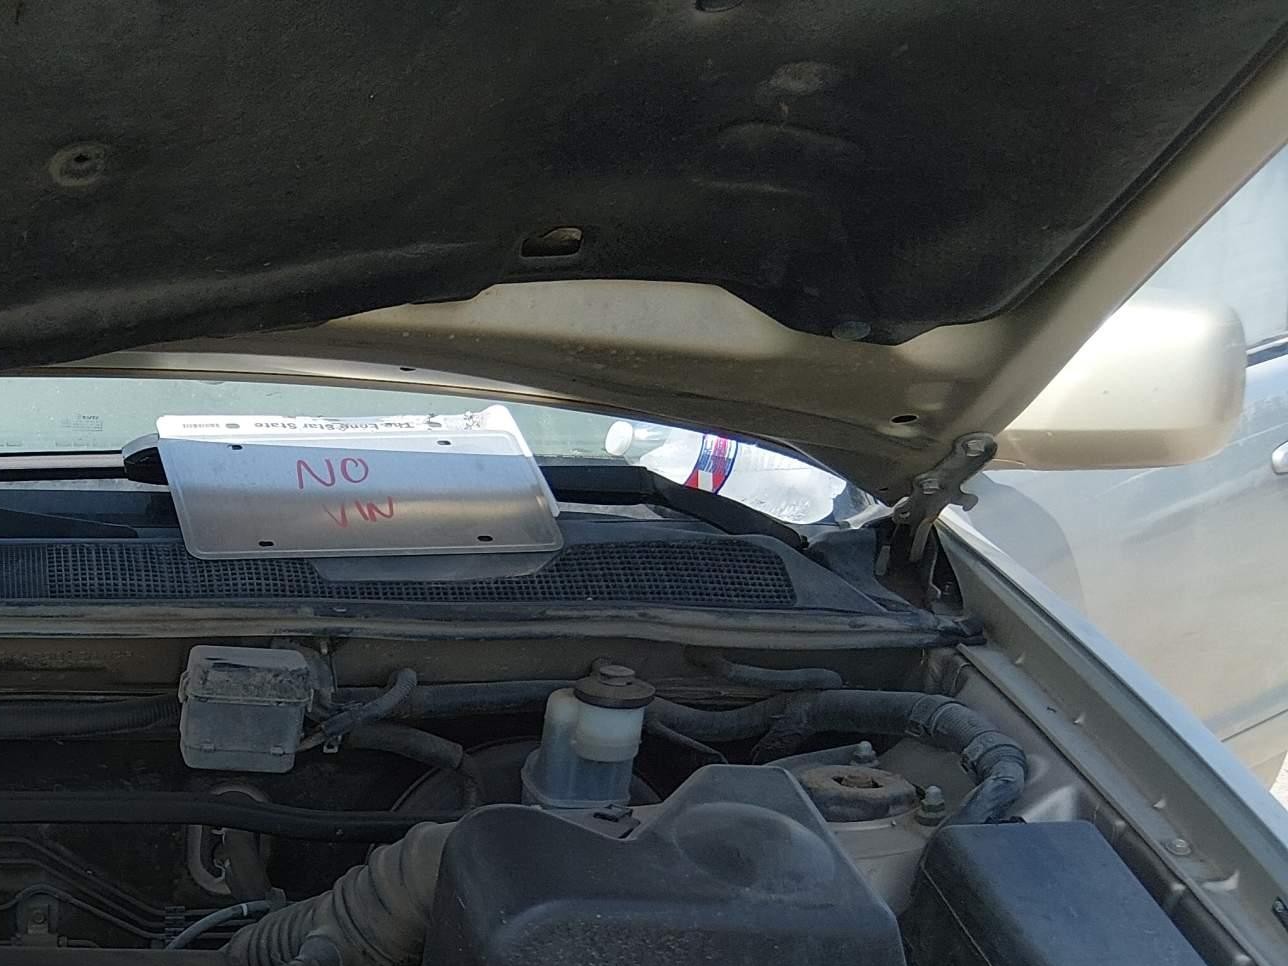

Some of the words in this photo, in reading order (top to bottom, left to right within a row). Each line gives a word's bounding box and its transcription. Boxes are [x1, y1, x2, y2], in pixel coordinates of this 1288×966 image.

[302, 421, 334, 430] Star
[383, 421, 415, 429] The
[296, 457, 369, 490] NO
[320, 496, 394, 528] VIN
